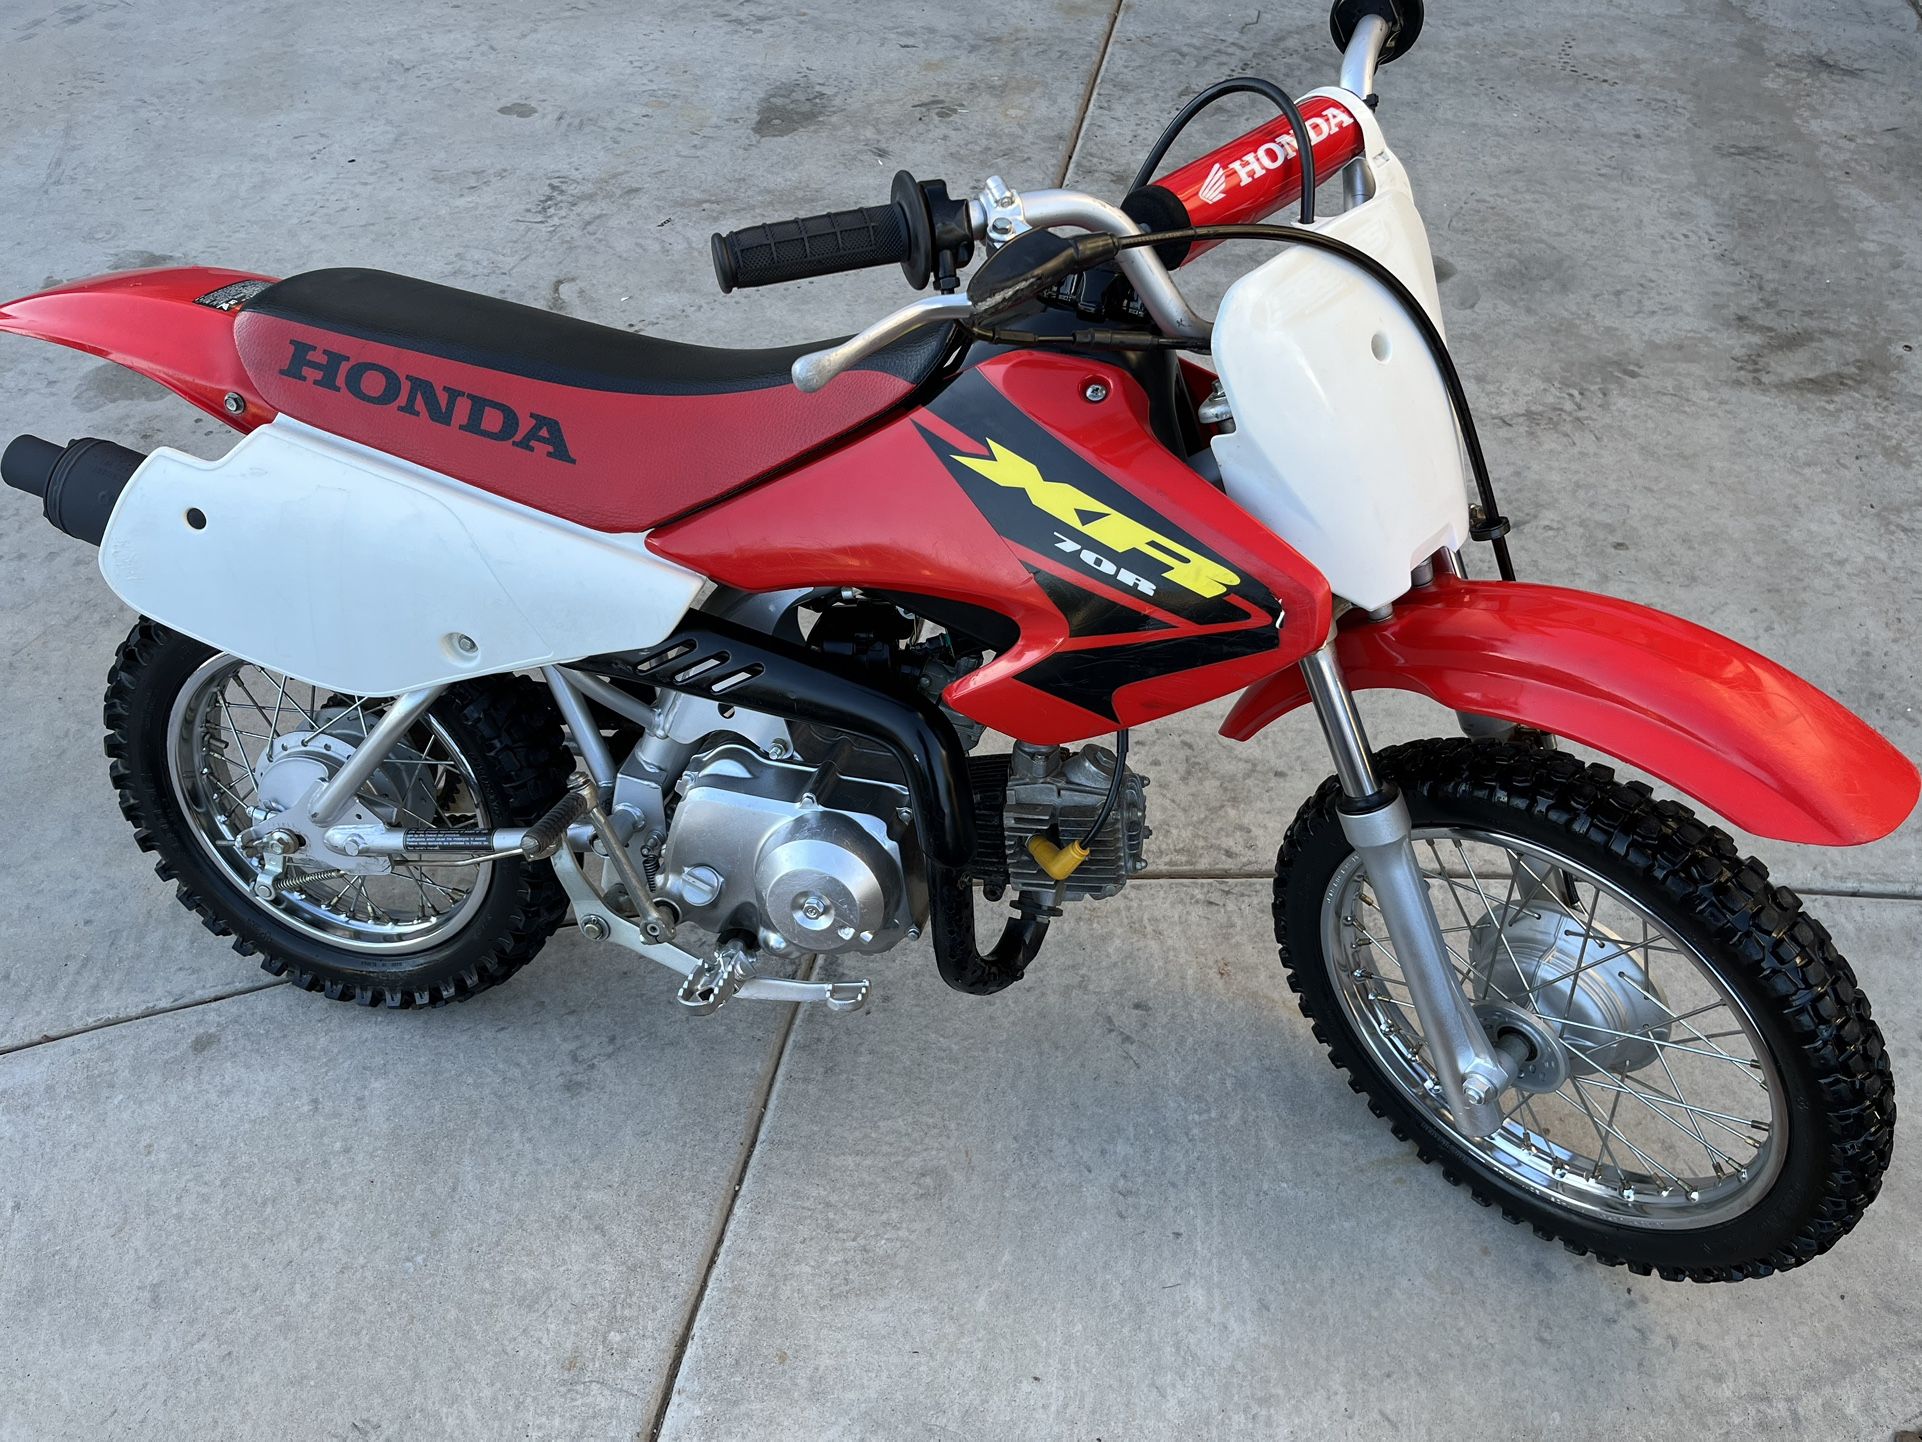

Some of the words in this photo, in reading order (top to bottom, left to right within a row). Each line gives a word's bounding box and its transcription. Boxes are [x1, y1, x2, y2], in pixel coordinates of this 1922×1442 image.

[1228, 106, 1355, 186] HONDA
[279, 339, 577, 465] HONDA
[1053, 531, 1157, 597] 70R
